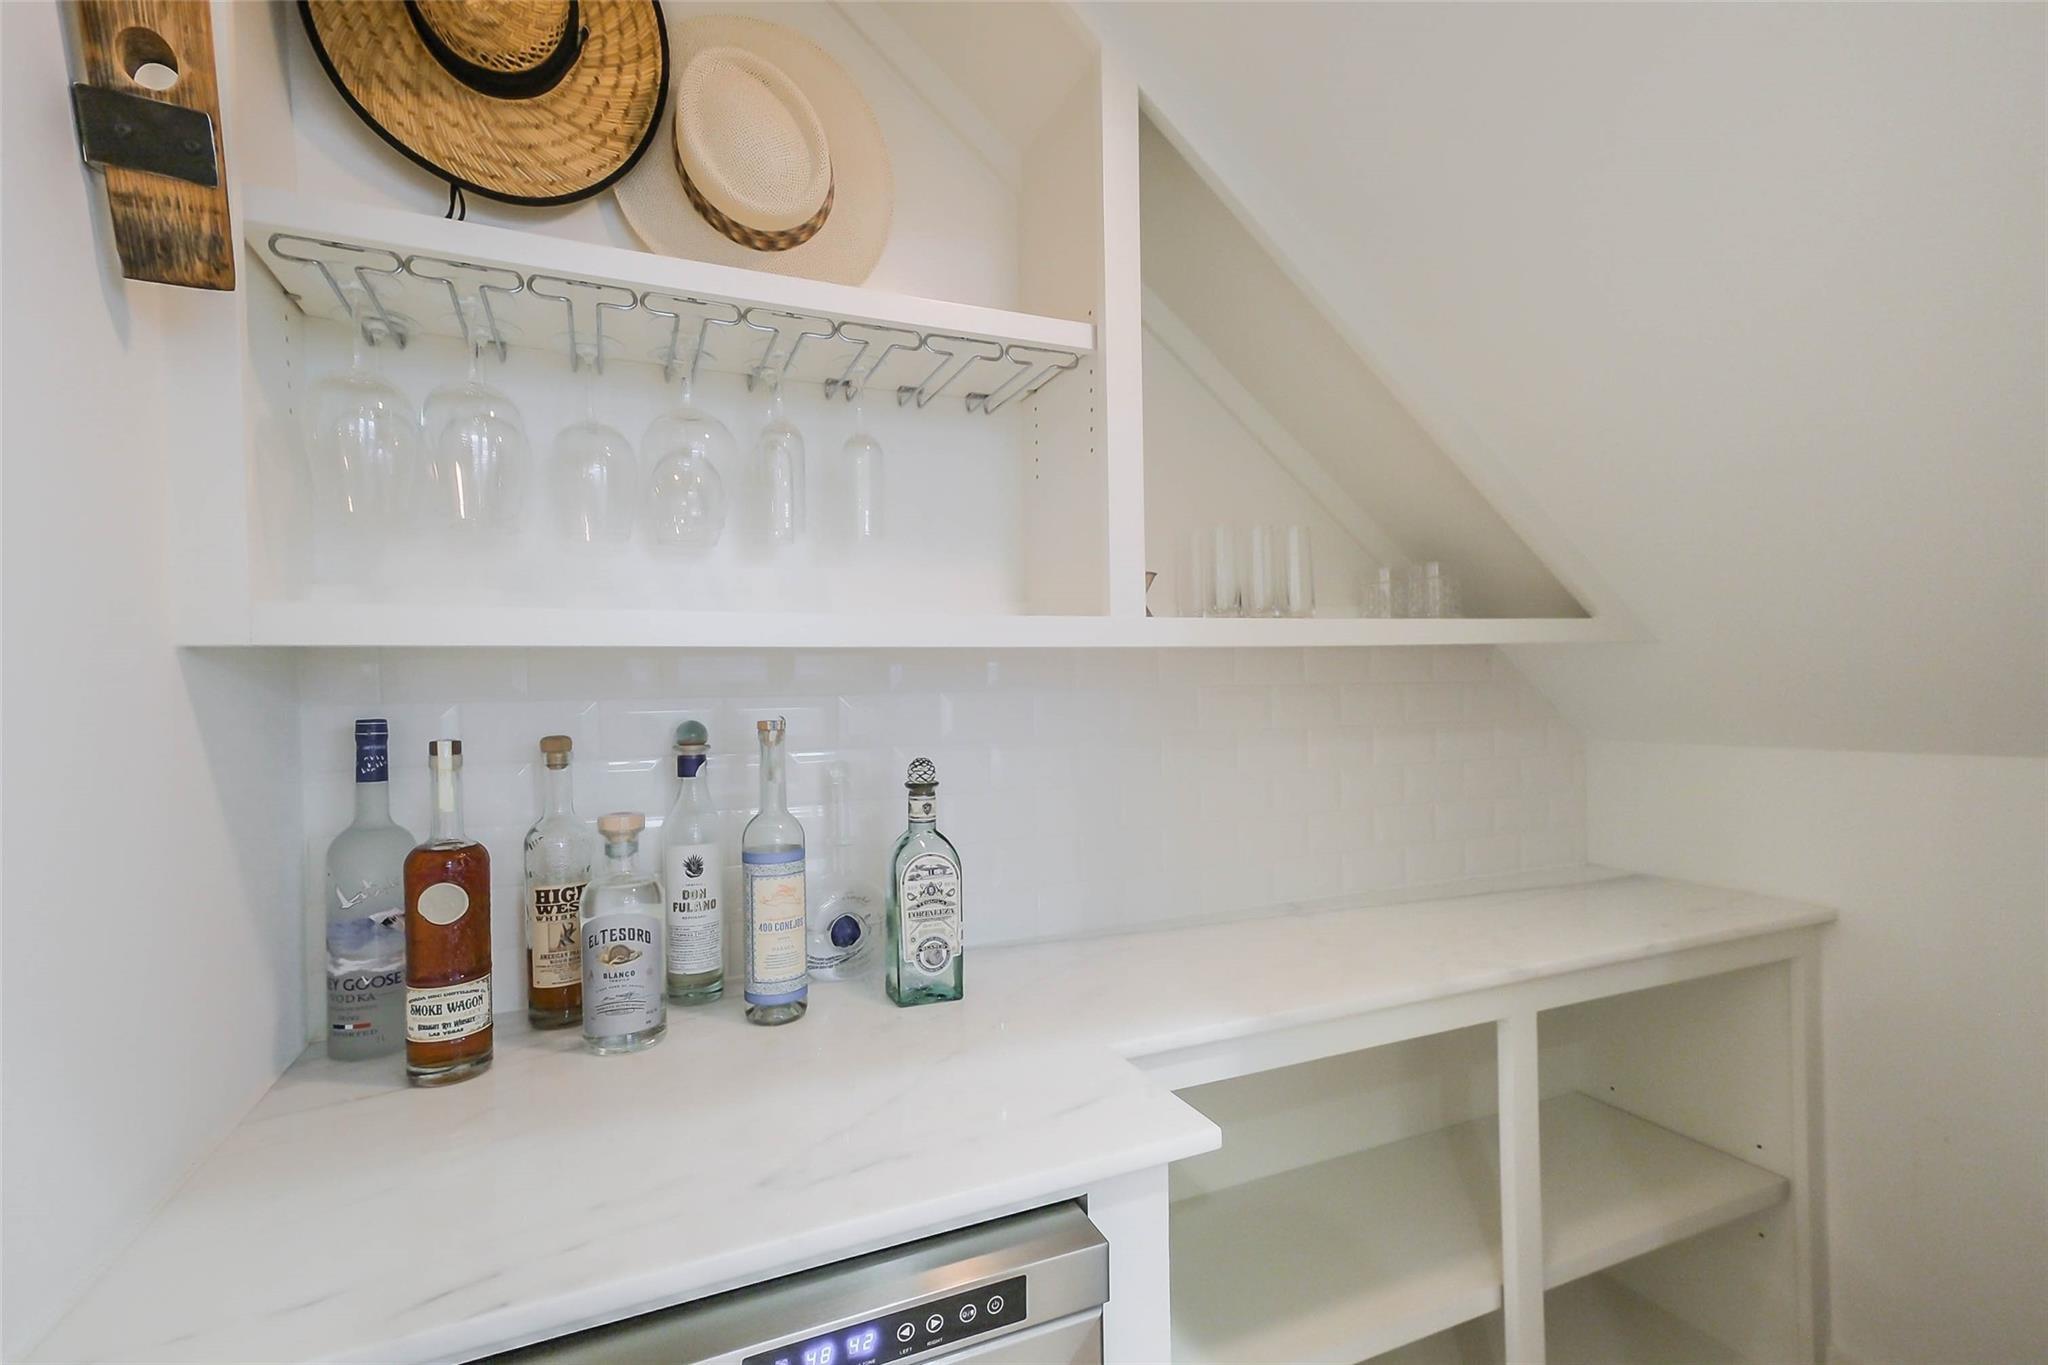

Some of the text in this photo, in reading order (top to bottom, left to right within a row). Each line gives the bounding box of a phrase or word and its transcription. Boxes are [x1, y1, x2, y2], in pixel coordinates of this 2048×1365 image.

[682, 888, 707, 900] DON
[535, 902, 580, 915] WES
[672, 899, 717, 912] FULANO
[535, 913, 577, 922] WHISK
[908, 908, 955, 919] FORTALEZA
[759, 917, 804, 933] 400 CONEJOS
[588, 928, 652, 949] EL TESORO
[343, 971, 402, 991] GOOSE
[603, 970, 636, 979] BLANCO
[410, 1004, 443, 1016] SMOKE
[447, 994, 484, 1013] WAGON
[926, 1337, 943, 1346] RIGHT
[806, 1332, 875, 1365] 48 42
[899, 1347, 913, 1355] LEFT
